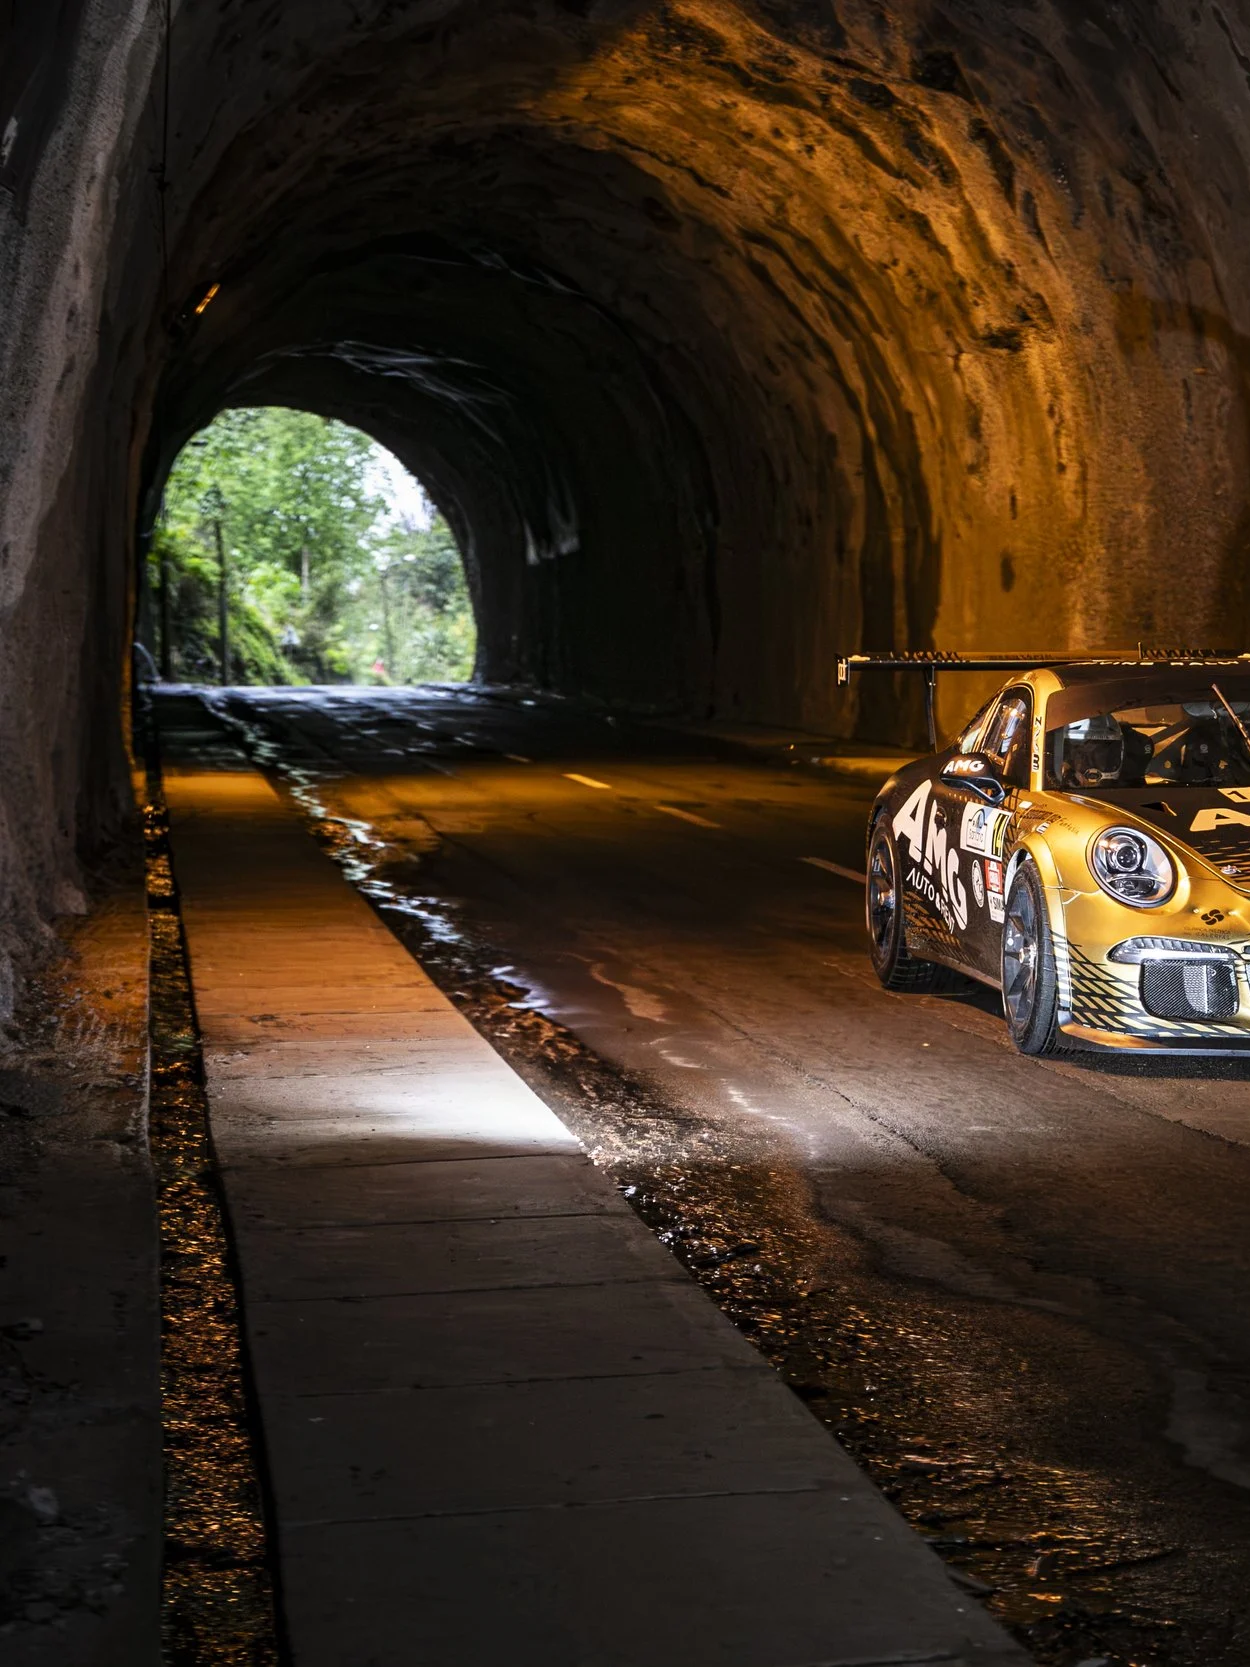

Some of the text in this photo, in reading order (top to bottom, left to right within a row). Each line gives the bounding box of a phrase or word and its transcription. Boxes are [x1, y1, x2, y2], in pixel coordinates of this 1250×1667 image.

[943, 760, 985, 774] AMG
[892, 779, 968, 931] AMG
[906, 867, 935, 901] AUTO
